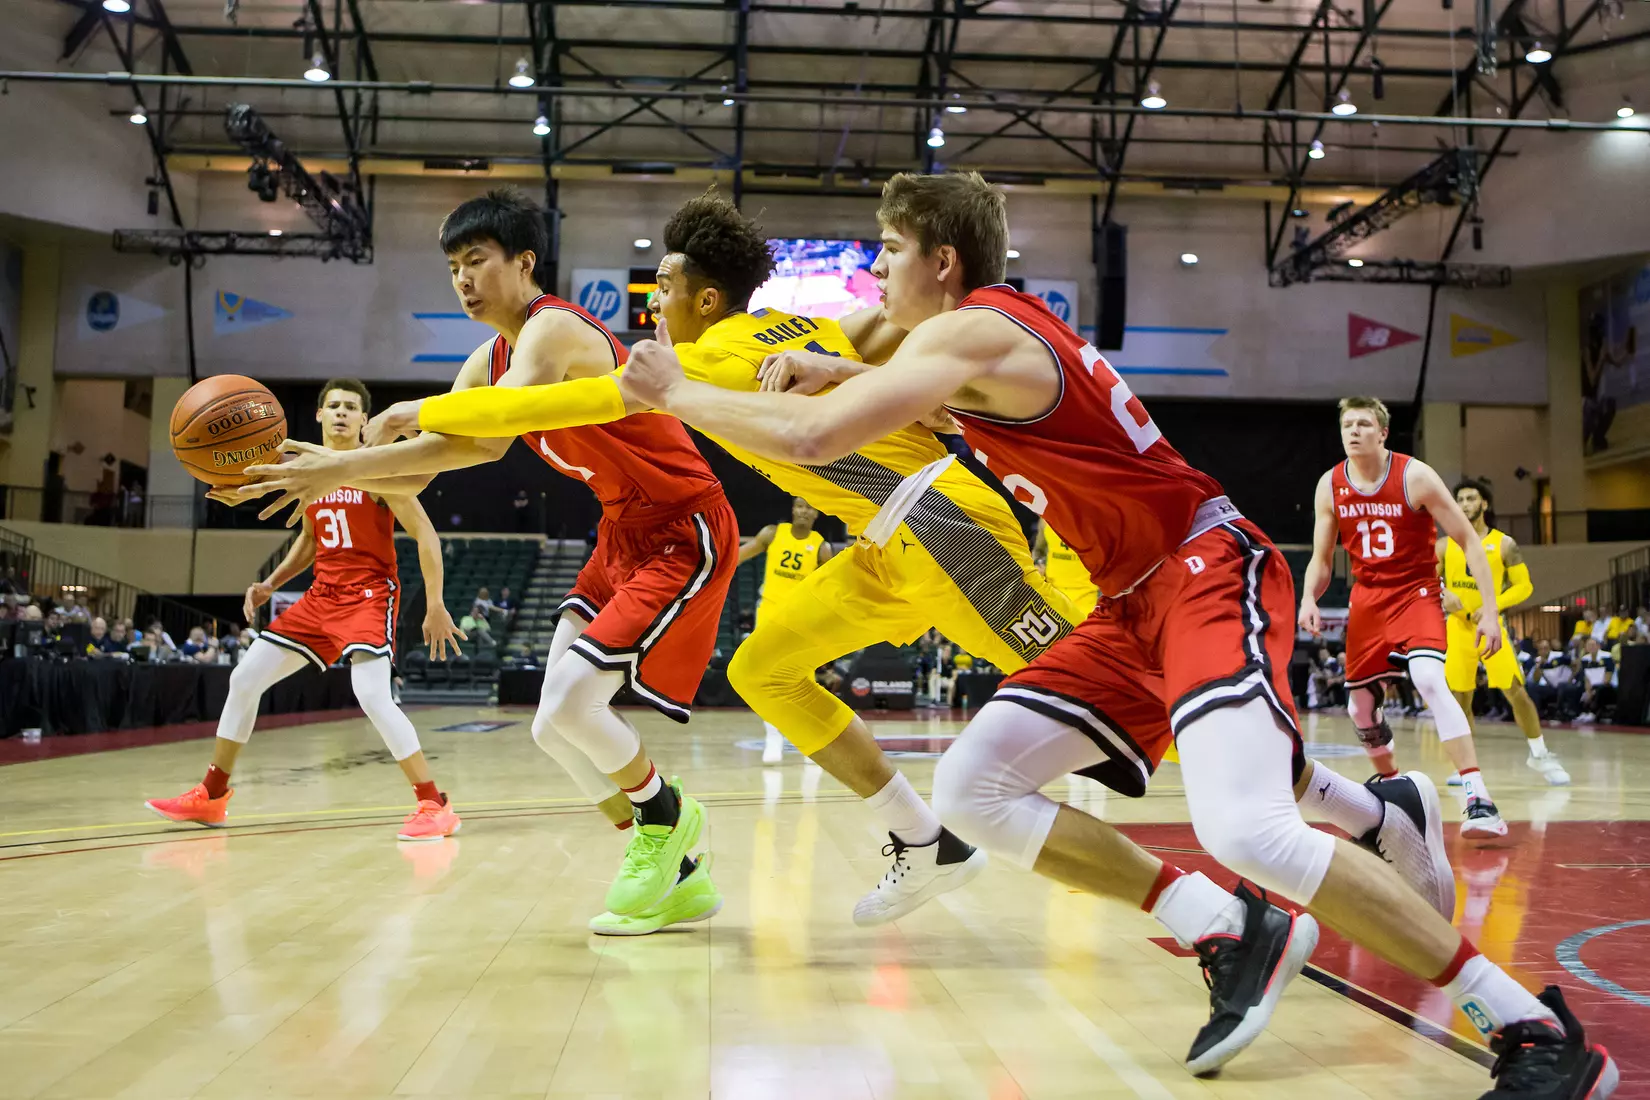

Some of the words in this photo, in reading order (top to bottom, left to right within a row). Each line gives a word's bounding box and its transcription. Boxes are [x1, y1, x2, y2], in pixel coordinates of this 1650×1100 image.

[584, 280, 618, 320] hp
[753, 315, 819, 346] BAILEY
[1338, 503, 1403, 518] DAVIDSON
[315, 508, 353, 549] 31
[1356, 519, 1395, 558] 13
[780, 550, 803, 570] 25
[1184, 556, 1206, 575] D
[1006, 604, 1060, 651] MU
